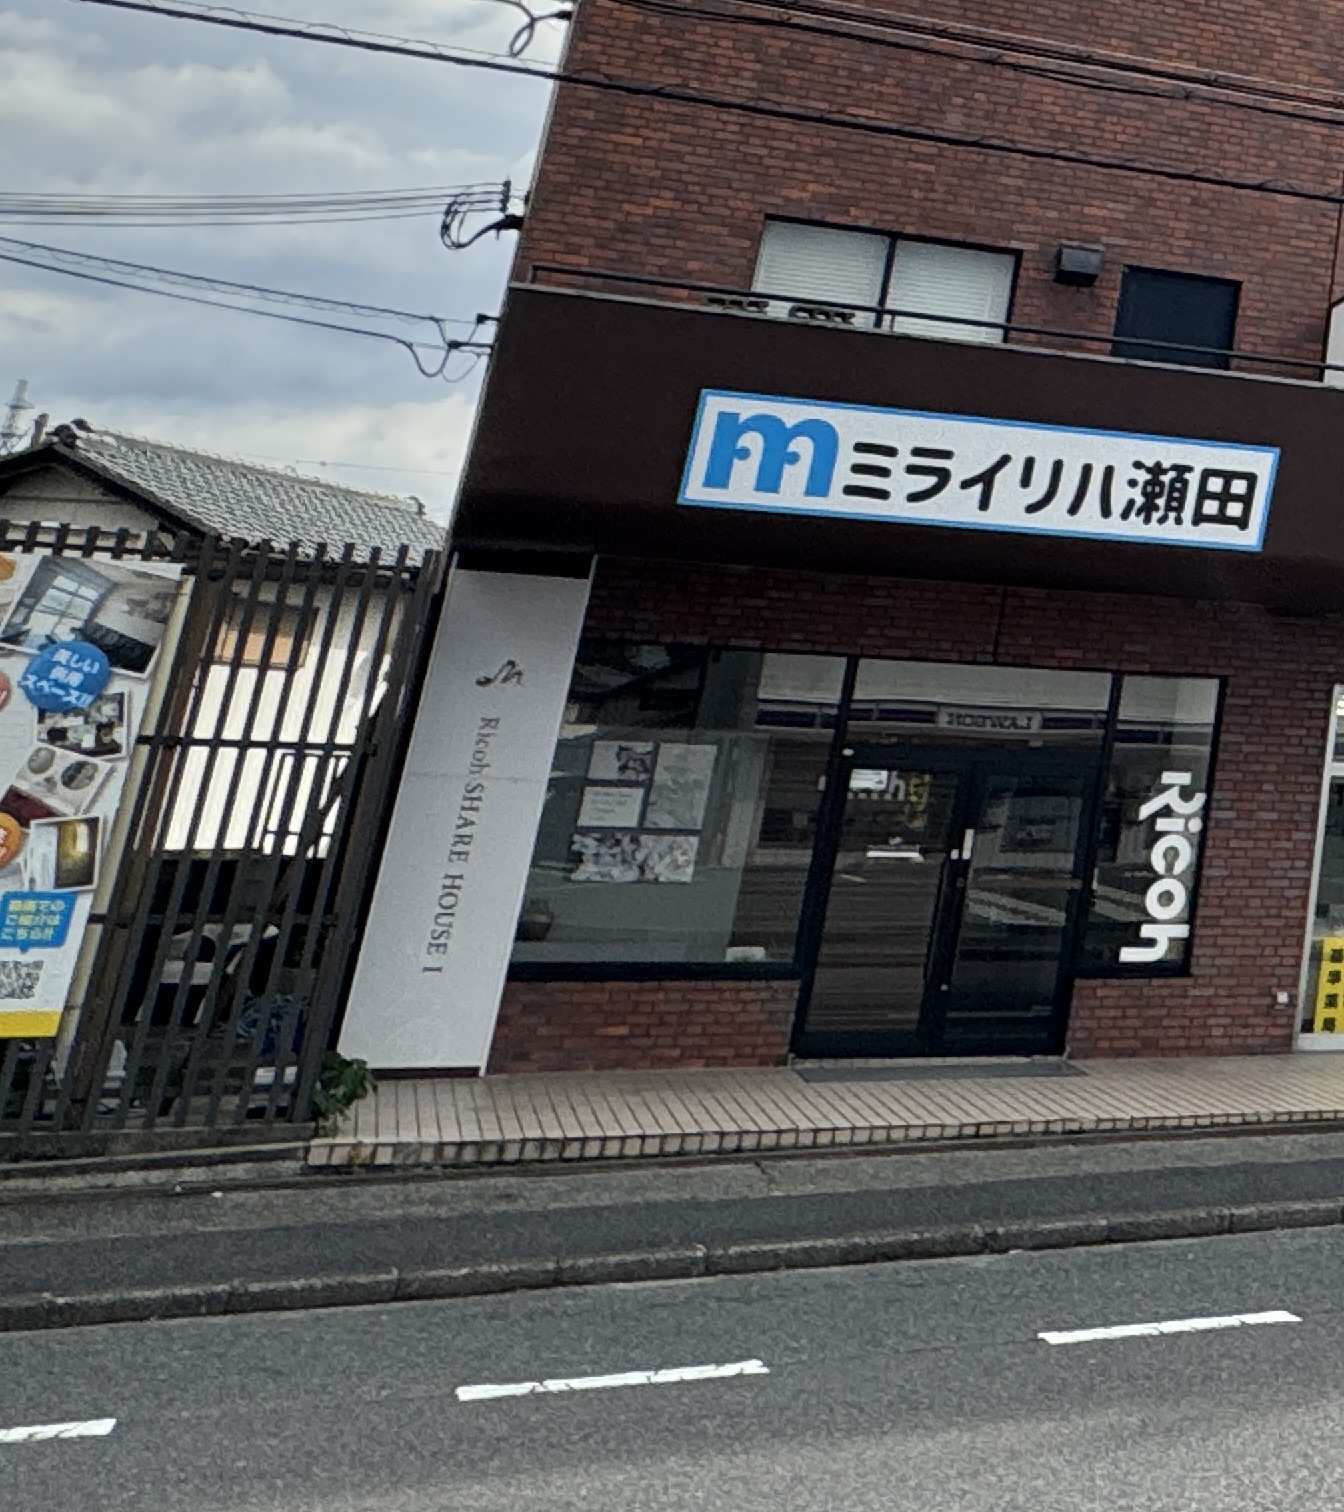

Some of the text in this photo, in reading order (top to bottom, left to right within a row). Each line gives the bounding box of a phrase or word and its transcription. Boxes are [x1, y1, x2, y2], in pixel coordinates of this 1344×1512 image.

[842, 440, 1257, 531] ミライリハ瀬田
[469, 715, 501, 776] Ricoh
[447, 783, 485, 864] SHARE
[1119, 770, 1208, 963] Ricoh
[426, 872, 464, 956] HOUSE
